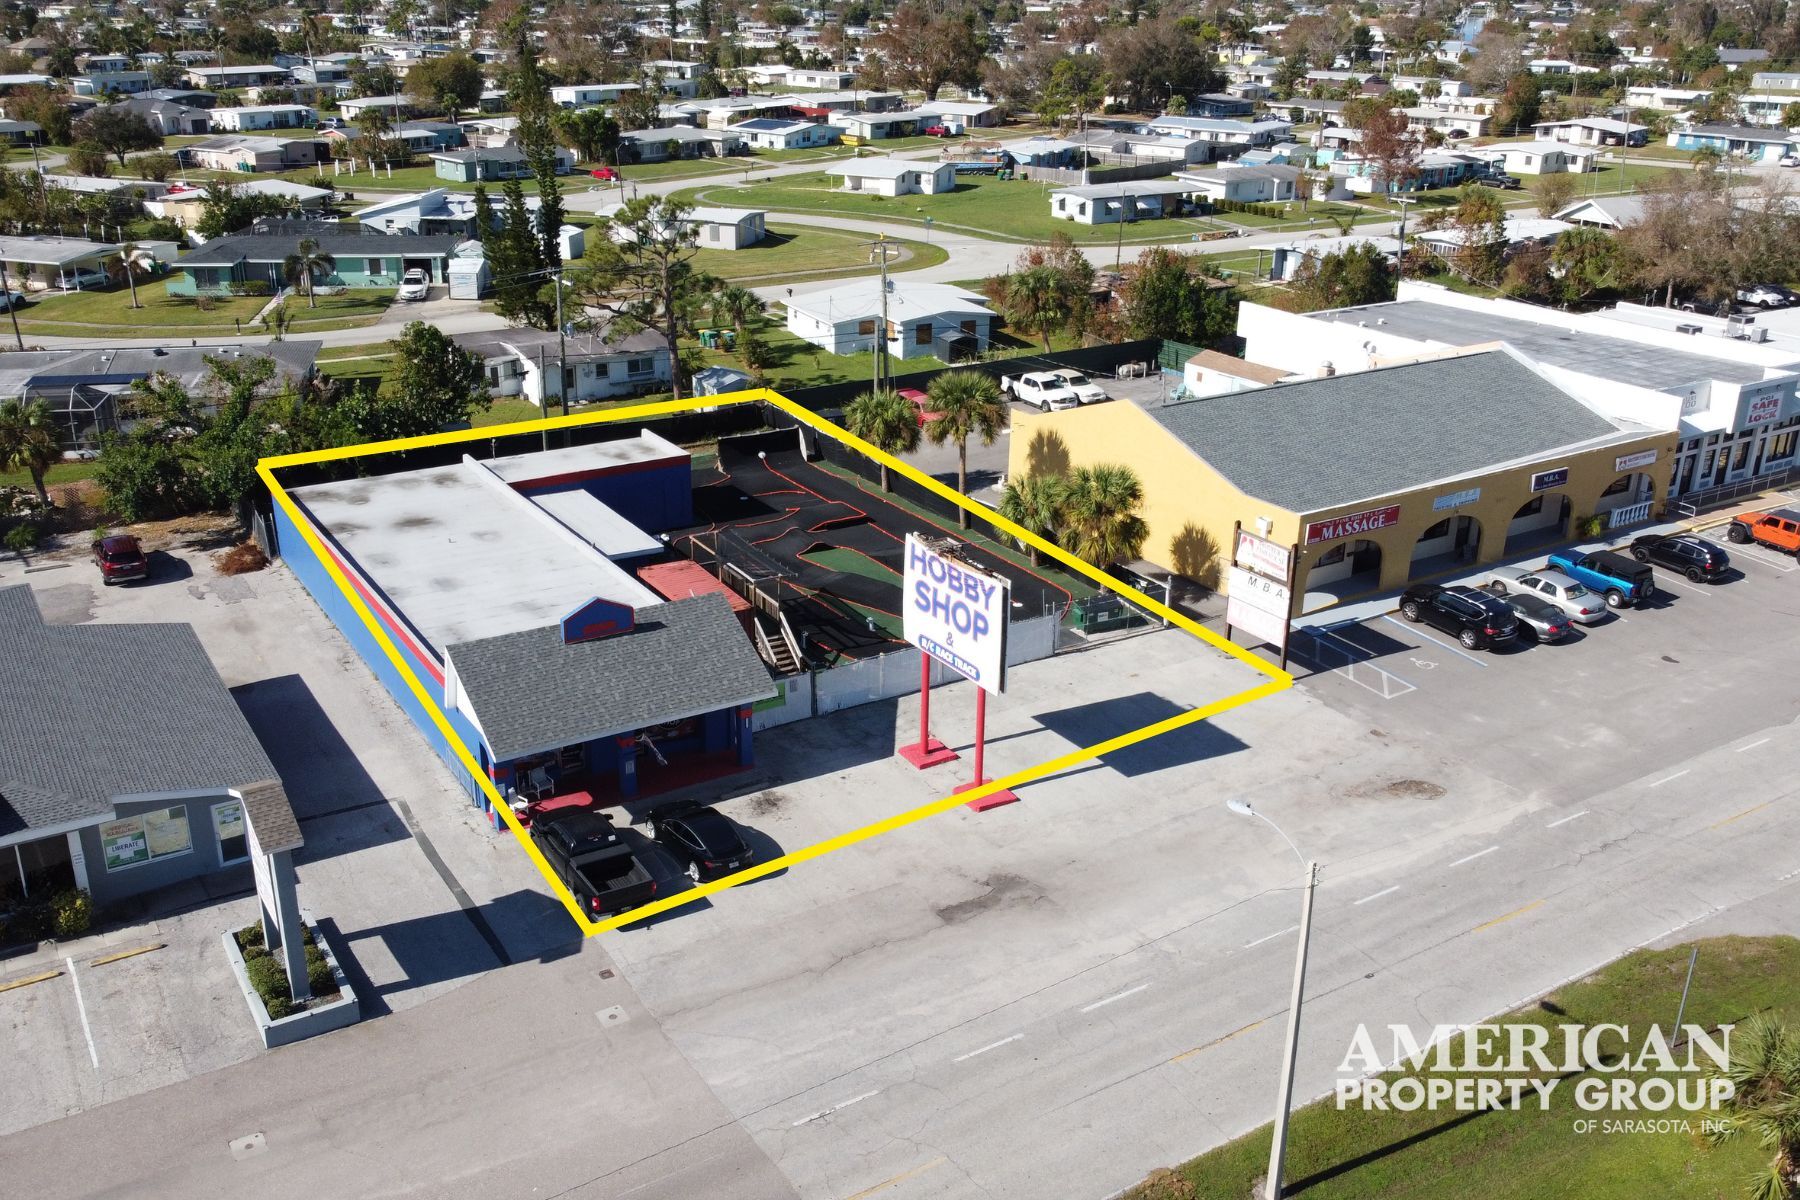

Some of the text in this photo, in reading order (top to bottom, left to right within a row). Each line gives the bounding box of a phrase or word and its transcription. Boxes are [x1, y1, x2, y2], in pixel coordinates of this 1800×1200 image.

[1752, 398, 1780, 410] SAFE
[1748, 409, 1777, 423] LOCK
[1321, 514, 1386, 541] MASSAGE
[910, 542, 996, 611] HOBBY
[914, 580, 989, 642] SHOP
[946, 631, 954, 648] &
[921, 637, 977, 679] R/C RACE TRACK
[111, 840, 140, 853] LIBERATE
